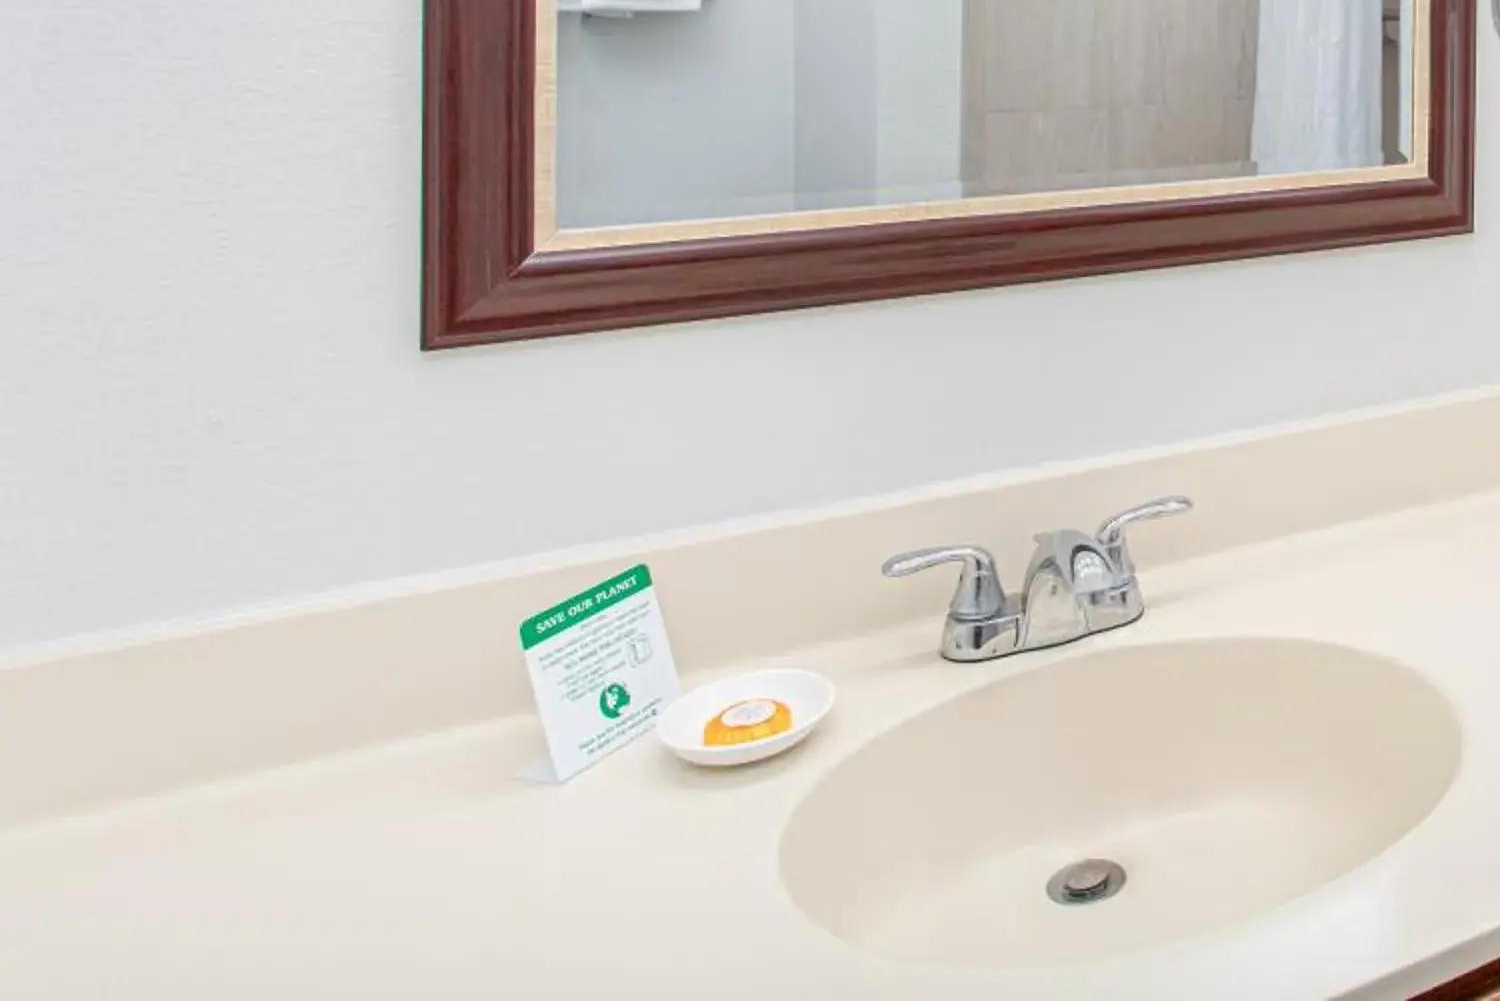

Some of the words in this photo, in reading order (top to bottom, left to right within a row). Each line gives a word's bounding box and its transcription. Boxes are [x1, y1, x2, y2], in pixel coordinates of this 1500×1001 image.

[536, 611, 565, 634] SAVE
[568, 599, 592, 616] OUR
[595, 575, 637, 603] PLANET
